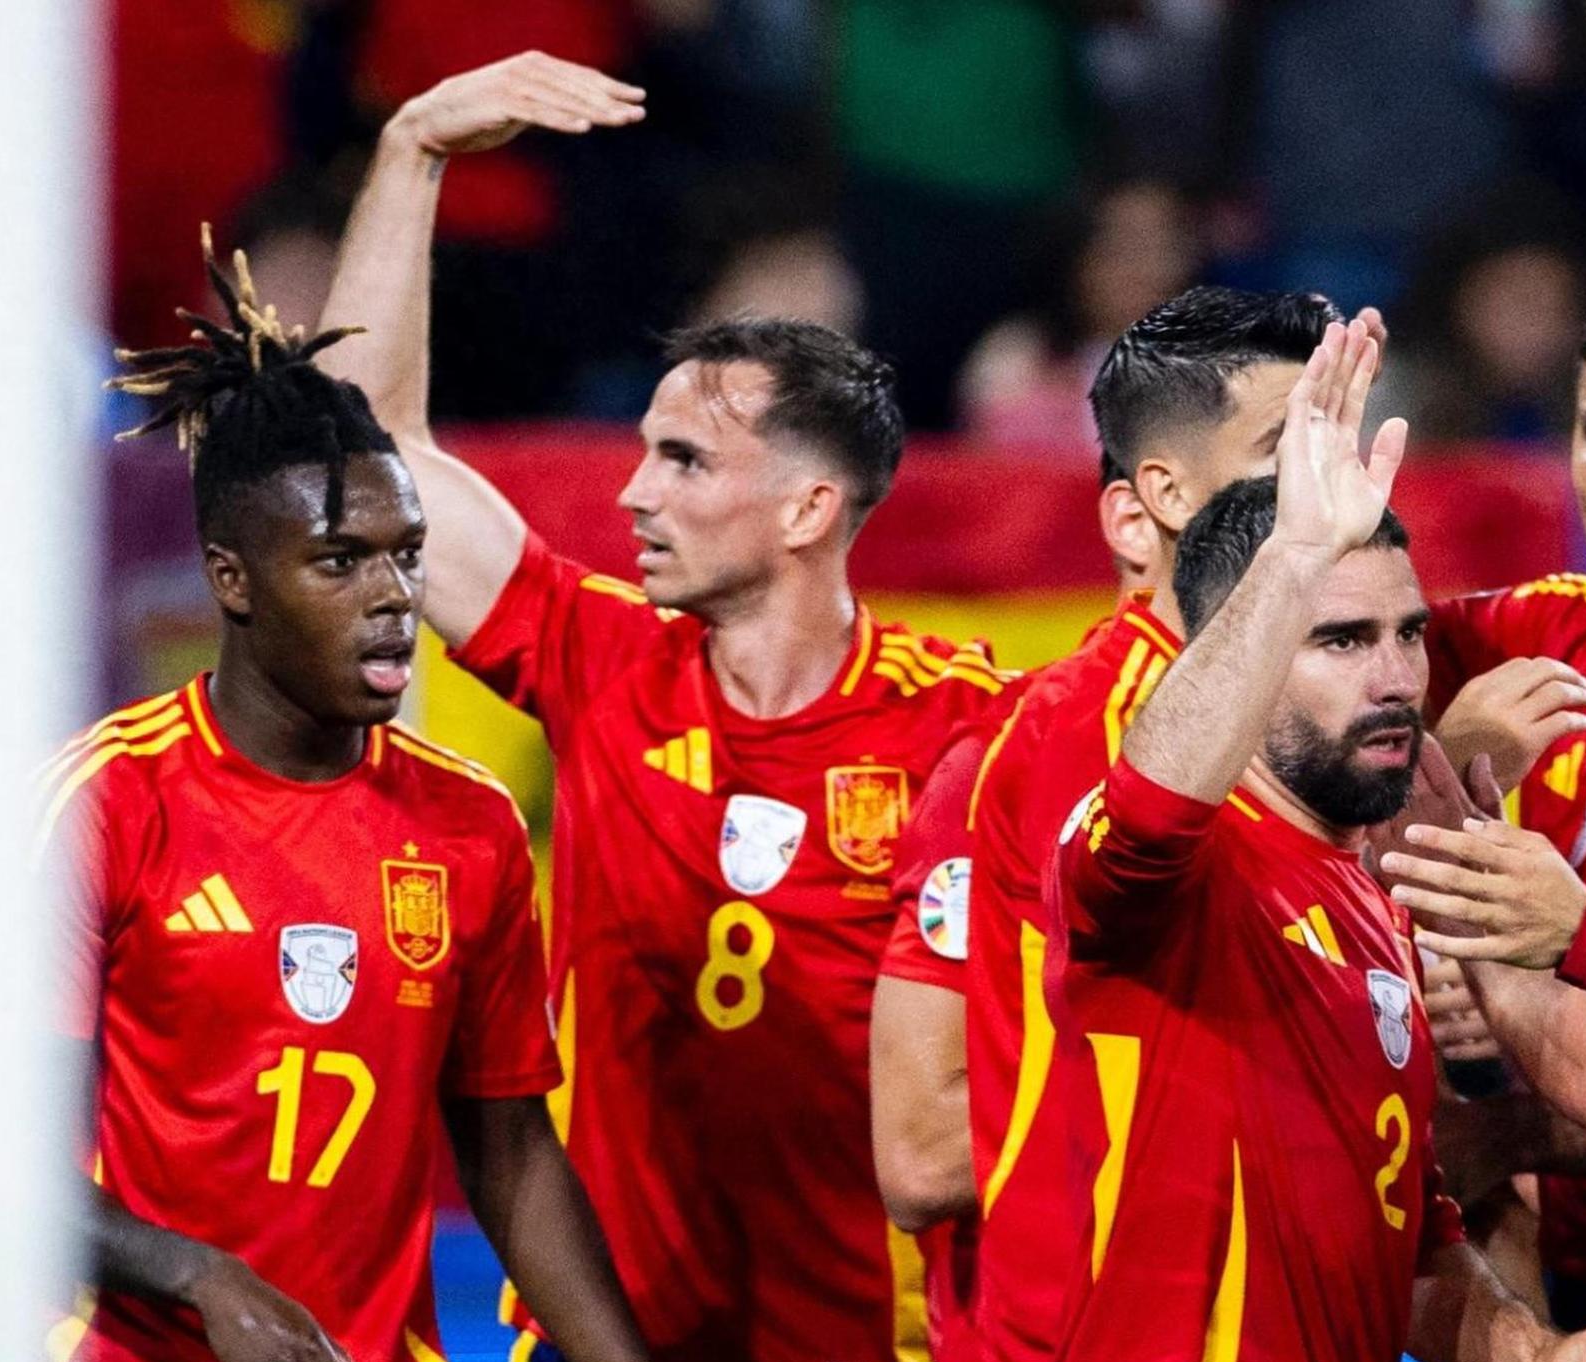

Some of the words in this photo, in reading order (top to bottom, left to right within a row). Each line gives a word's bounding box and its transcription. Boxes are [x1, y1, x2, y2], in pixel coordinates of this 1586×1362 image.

[696, 900, 775, 1031] 8
[256, 1046, 377, 1187] 17
[1374, 1092, 1411, 1230] 2
